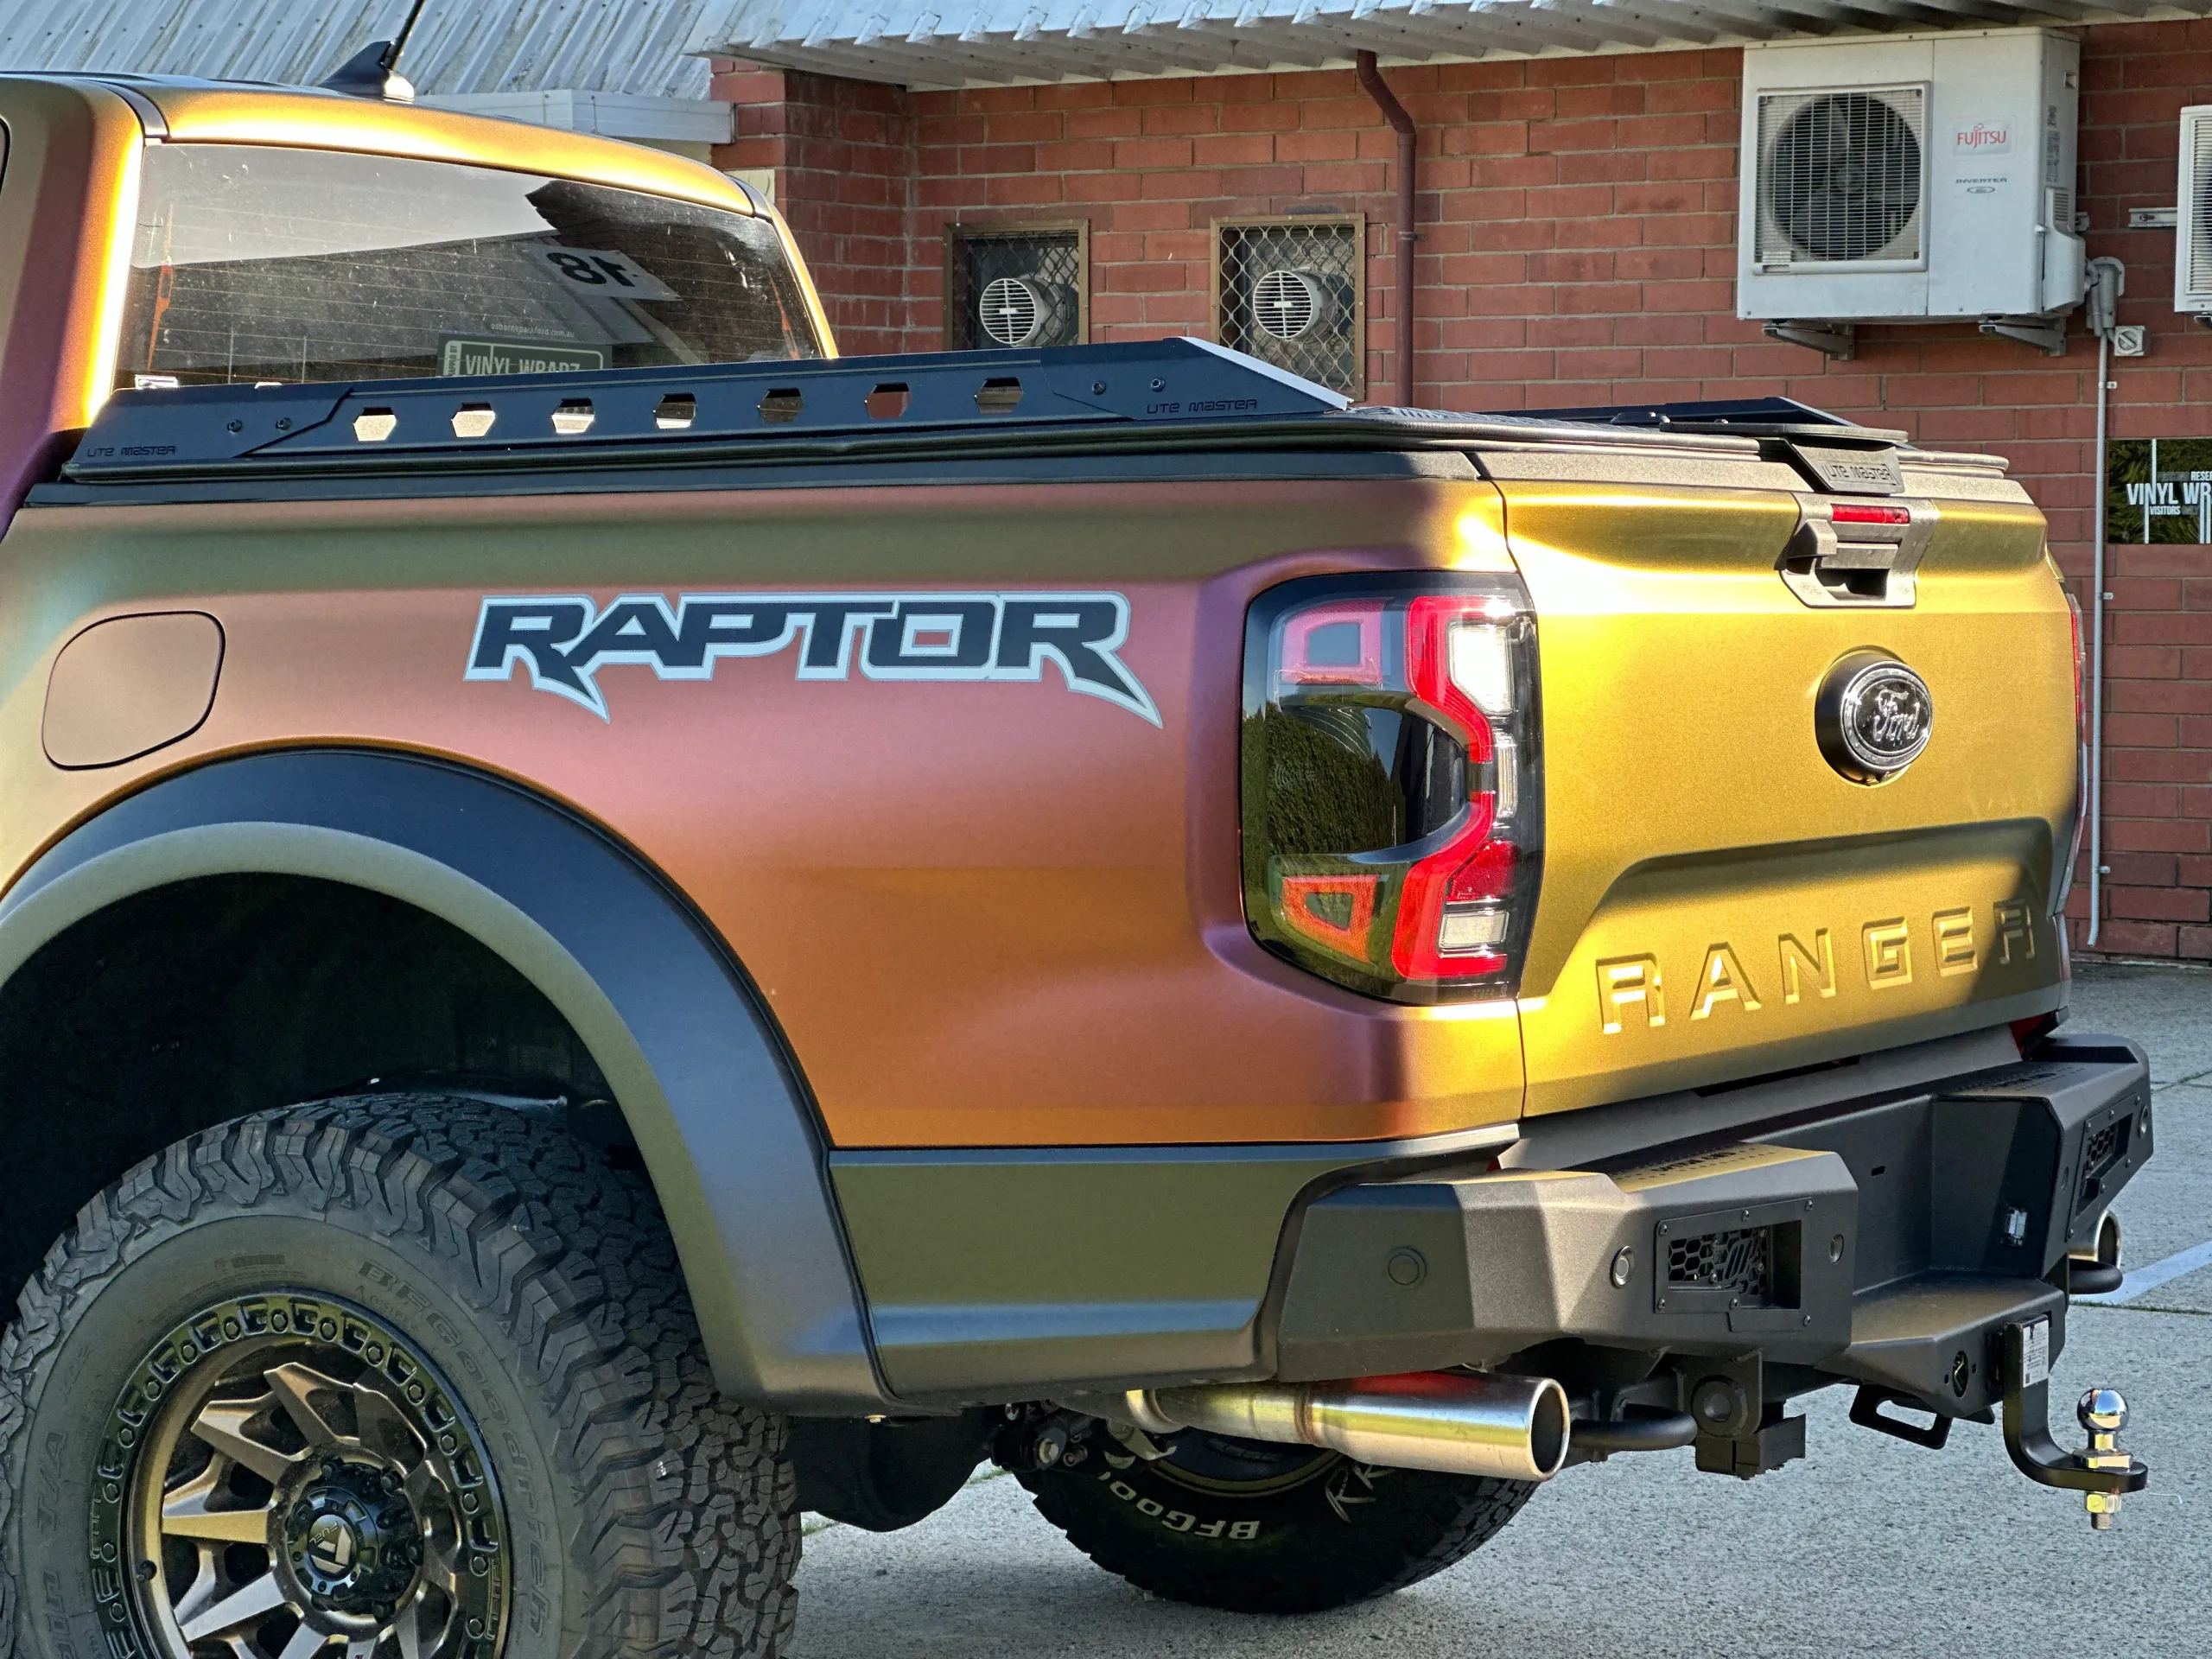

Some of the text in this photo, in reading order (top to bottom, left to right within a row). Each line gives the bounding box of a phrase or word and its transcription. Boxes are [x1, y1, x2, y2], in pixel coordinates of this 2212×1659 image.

[1957, 123, 2006, 149] FUJITSU
[2150, 505, 2181, 515] VISITORS
[463, 591, 1163, 728] RAPTOR
[1872, 689, 1921, 743] Ford
[1595, 899, 2036, 1035] RANGER
[308, 1521, 339, 1545] FUEL
